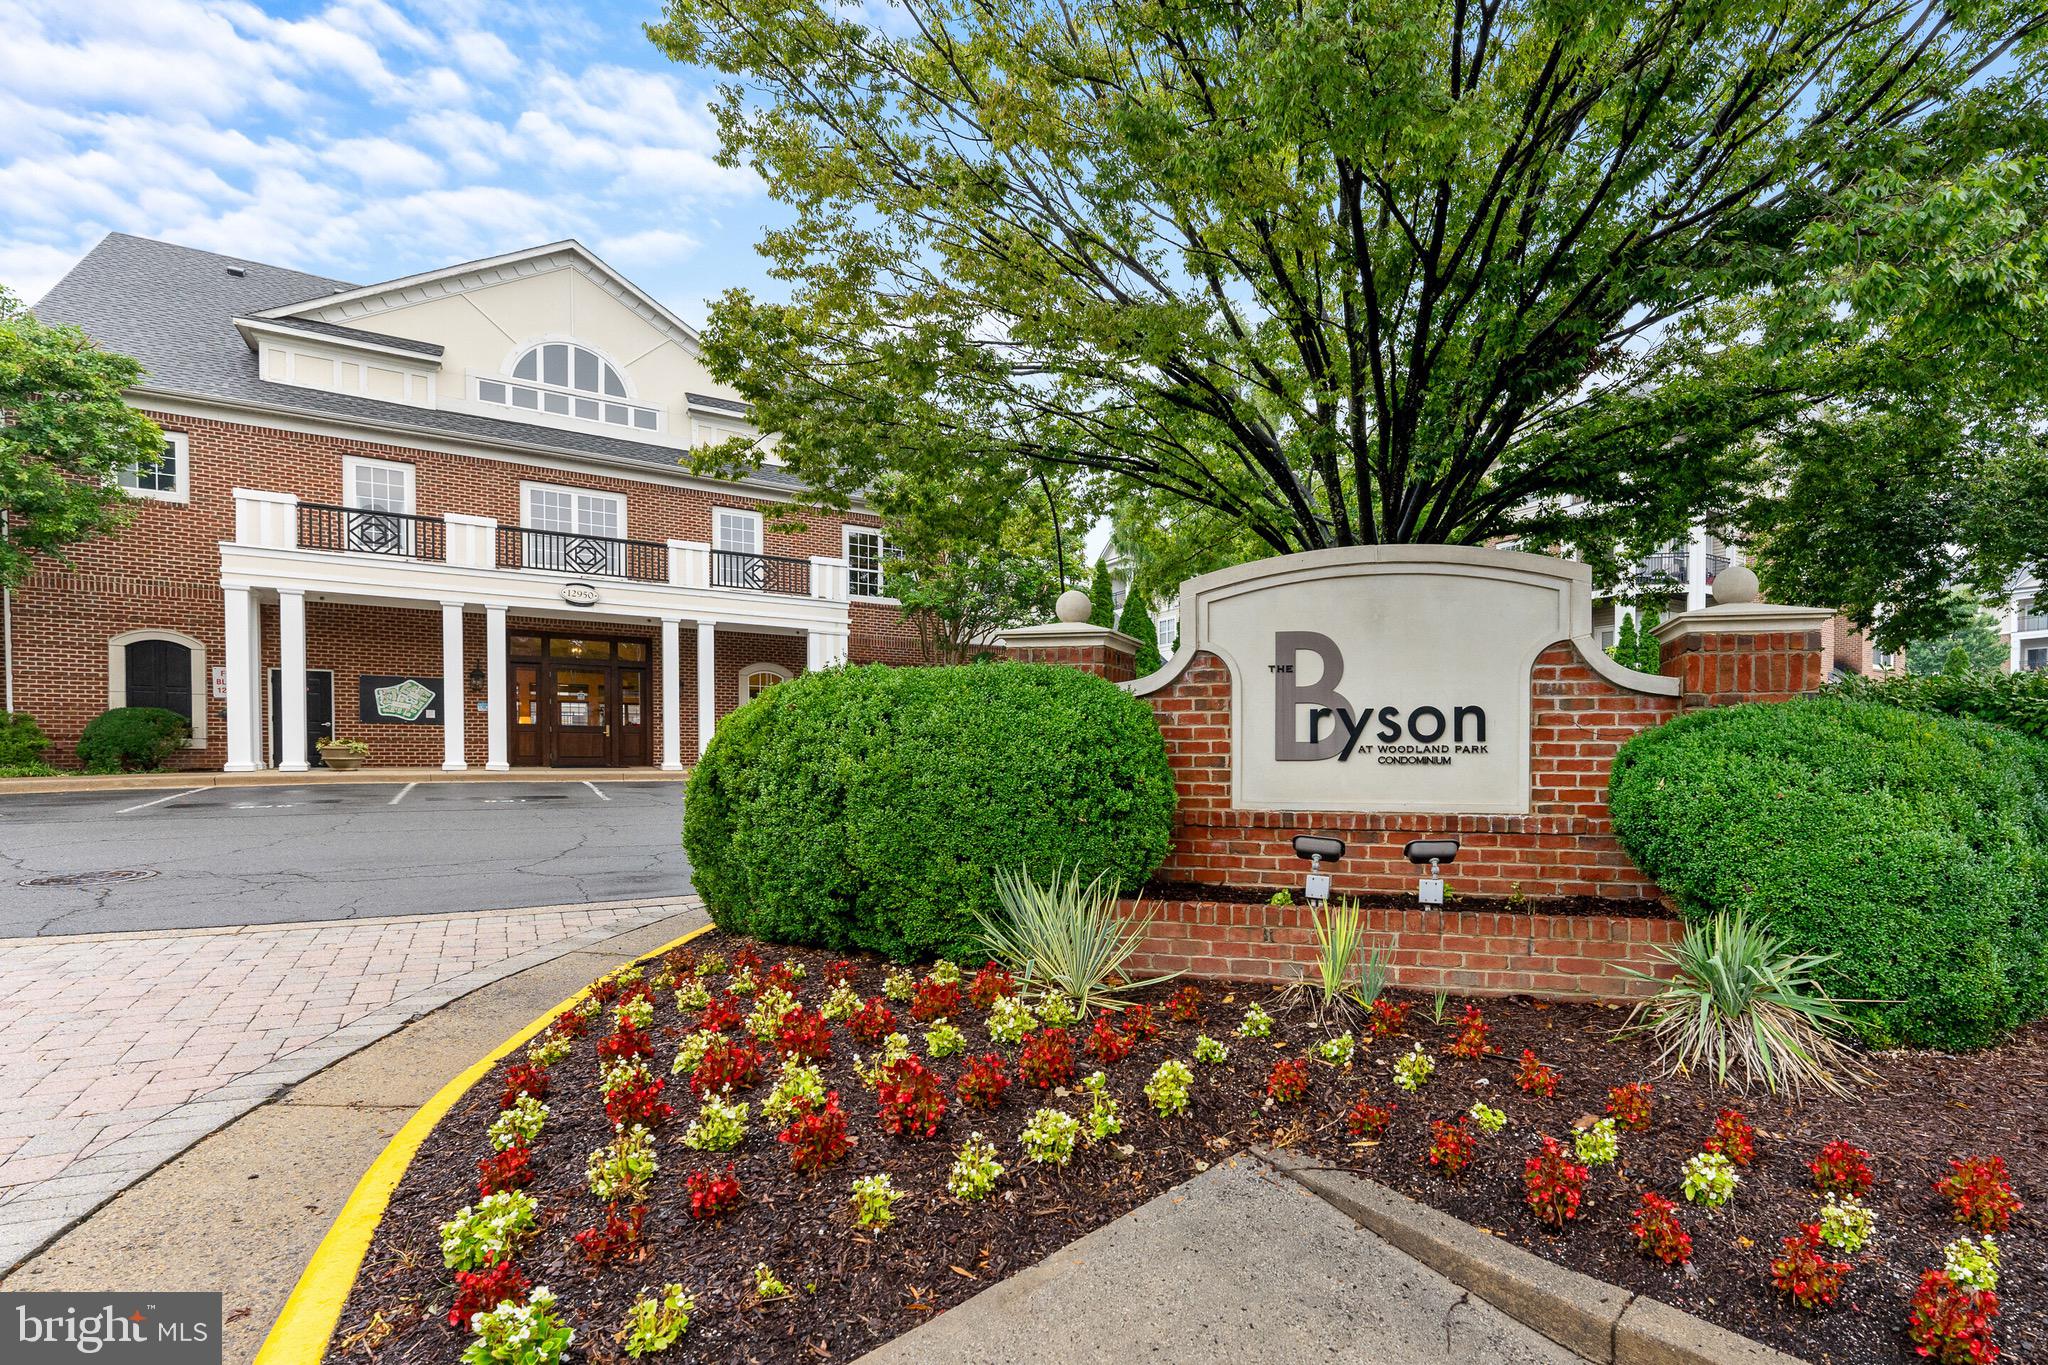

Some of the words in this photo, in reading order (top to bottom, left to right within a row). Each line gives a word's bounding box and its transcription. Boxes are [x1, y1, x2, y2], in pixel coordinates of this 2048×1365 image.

[567, 590, 594, 599] 12950
[1268, 664, 1294, 673] THE
[1275, 631, 1486, 762] Bryson
[1358, 745, 1374, 754] AT
[1378, 745, 1450, 754] WOODLAND
[1454, 745, 1489, 754] PARK
[1377, 756, 1451, 765] CONDOMINIUM
